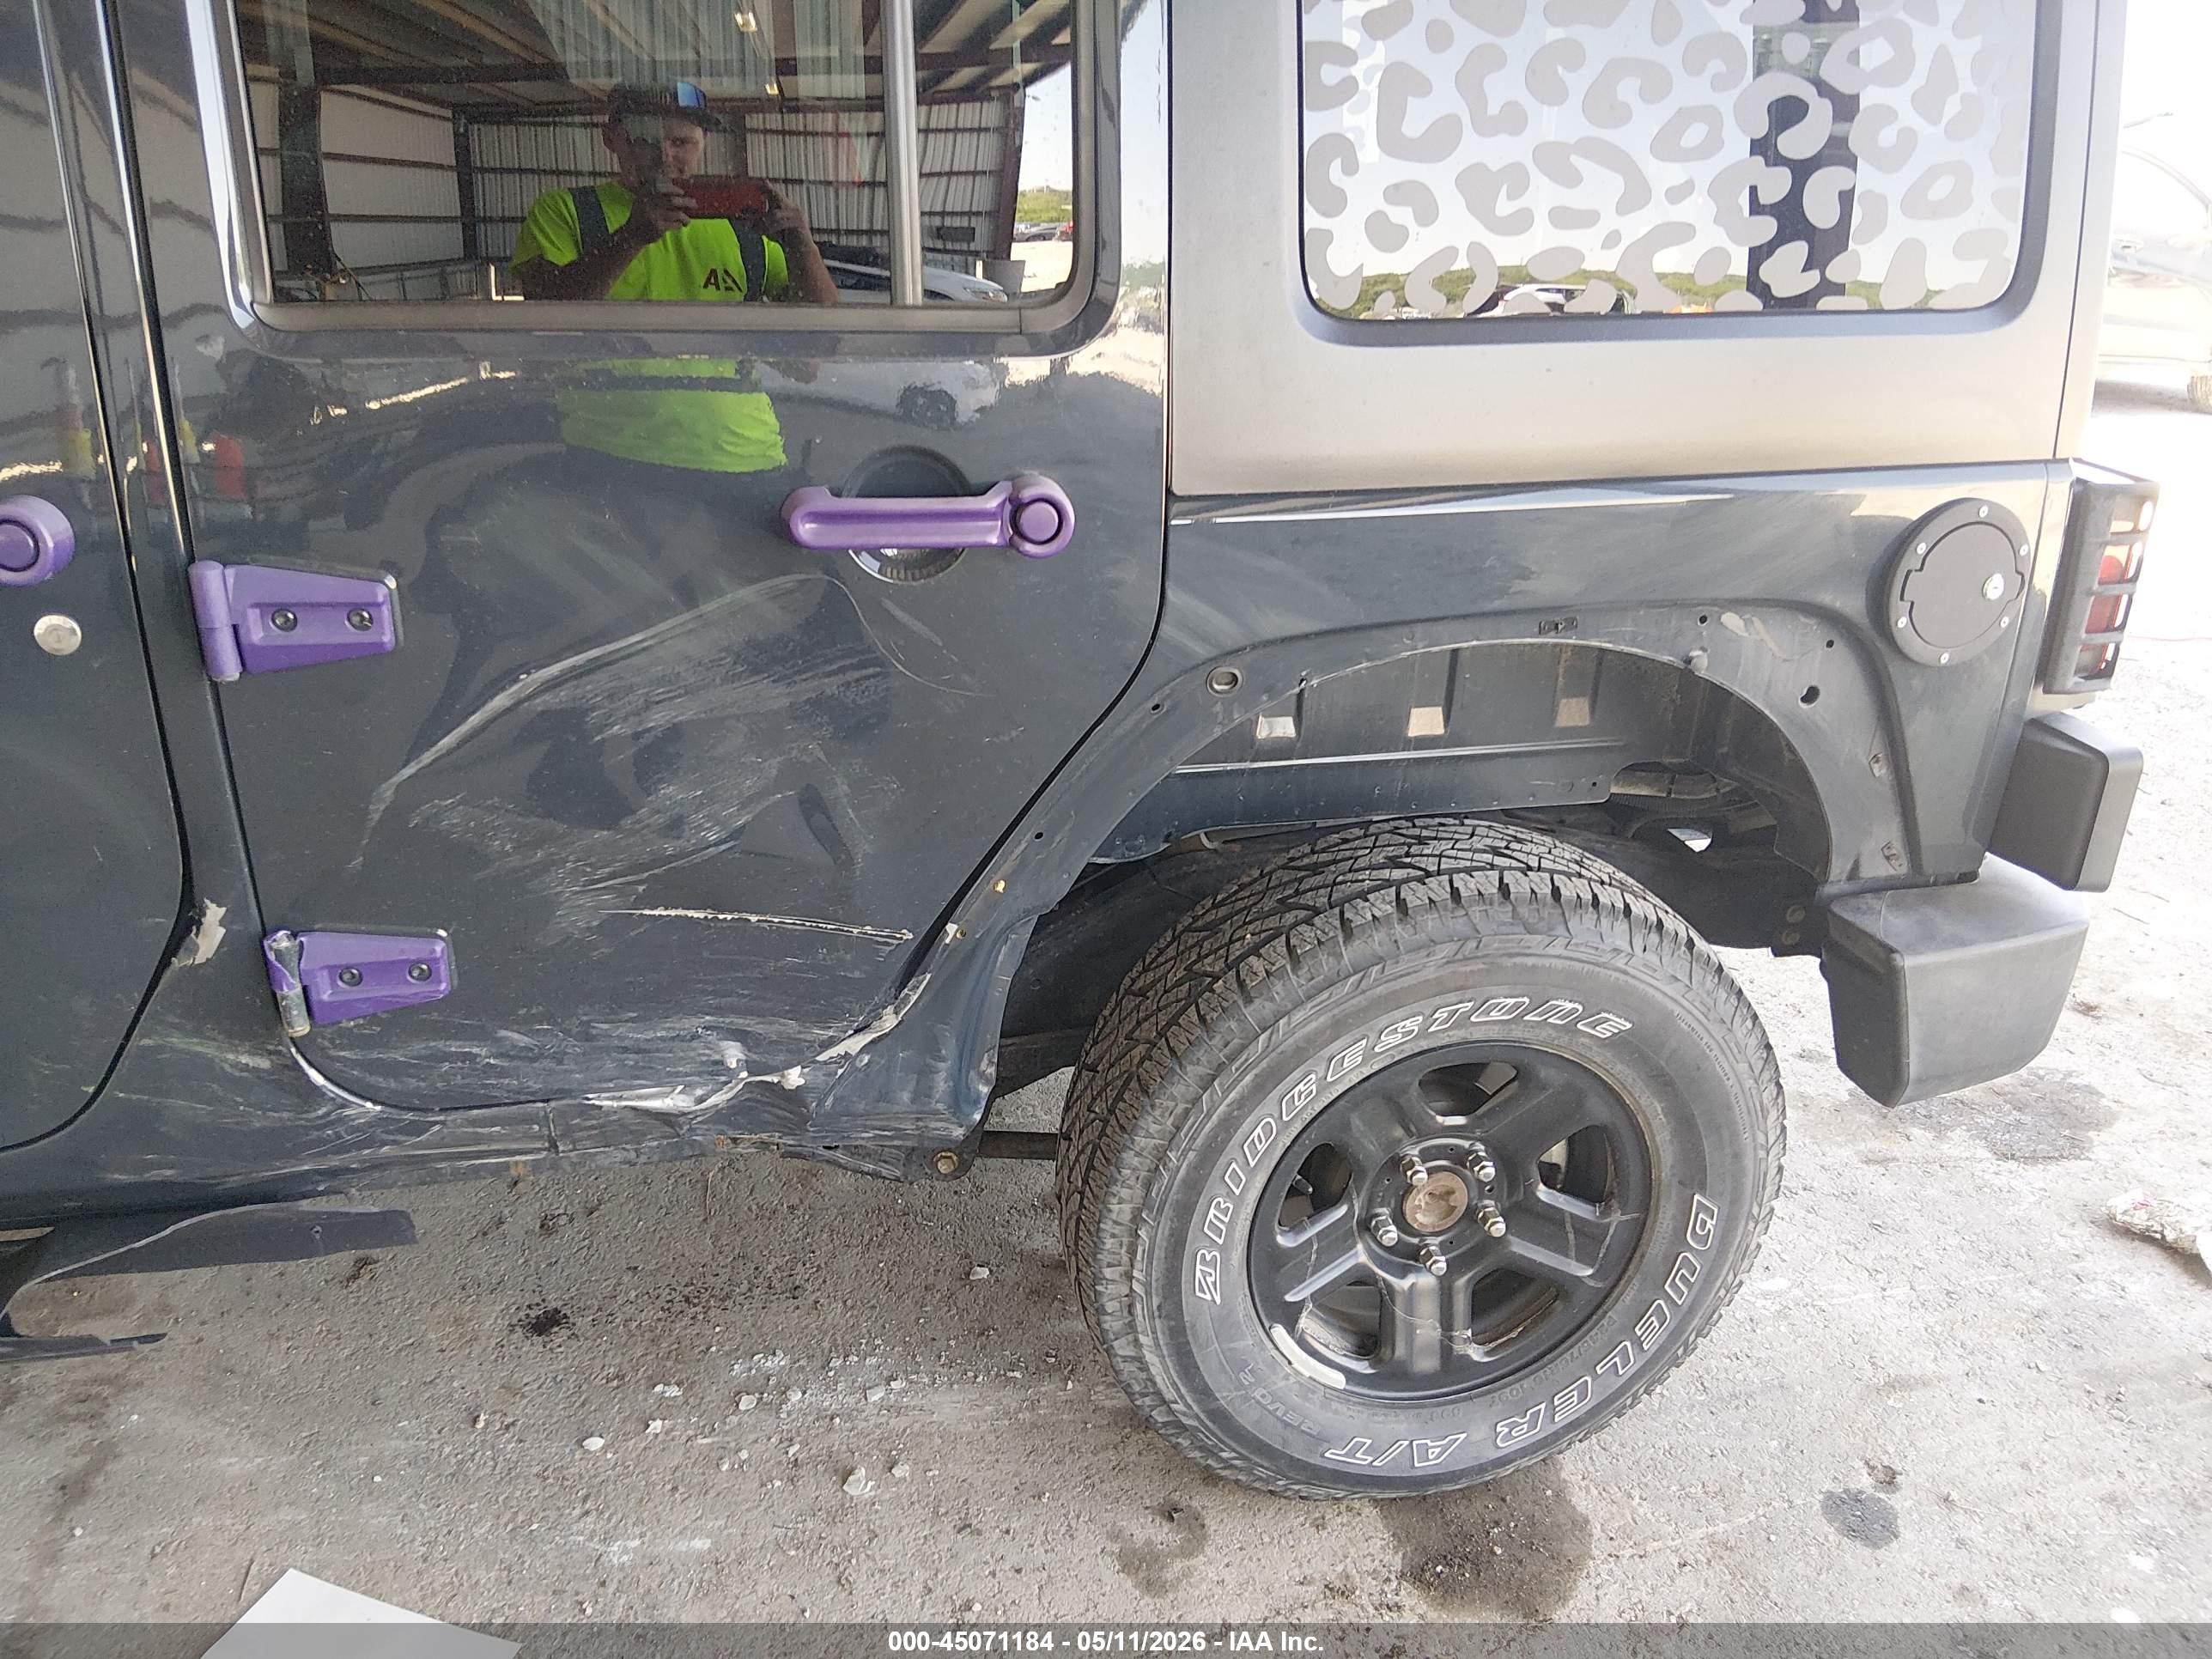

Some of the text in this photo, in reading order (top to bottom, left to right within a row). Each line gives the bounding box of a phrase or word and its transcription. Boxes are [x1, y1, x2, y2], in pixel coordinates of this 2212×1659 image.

[1194, 997, 1633, 1305] BRIDGESTONE
[1239, 1363, 1320, 1436] REVO 2
[1324, 1193, 1718, 1467] DUELER A/T
